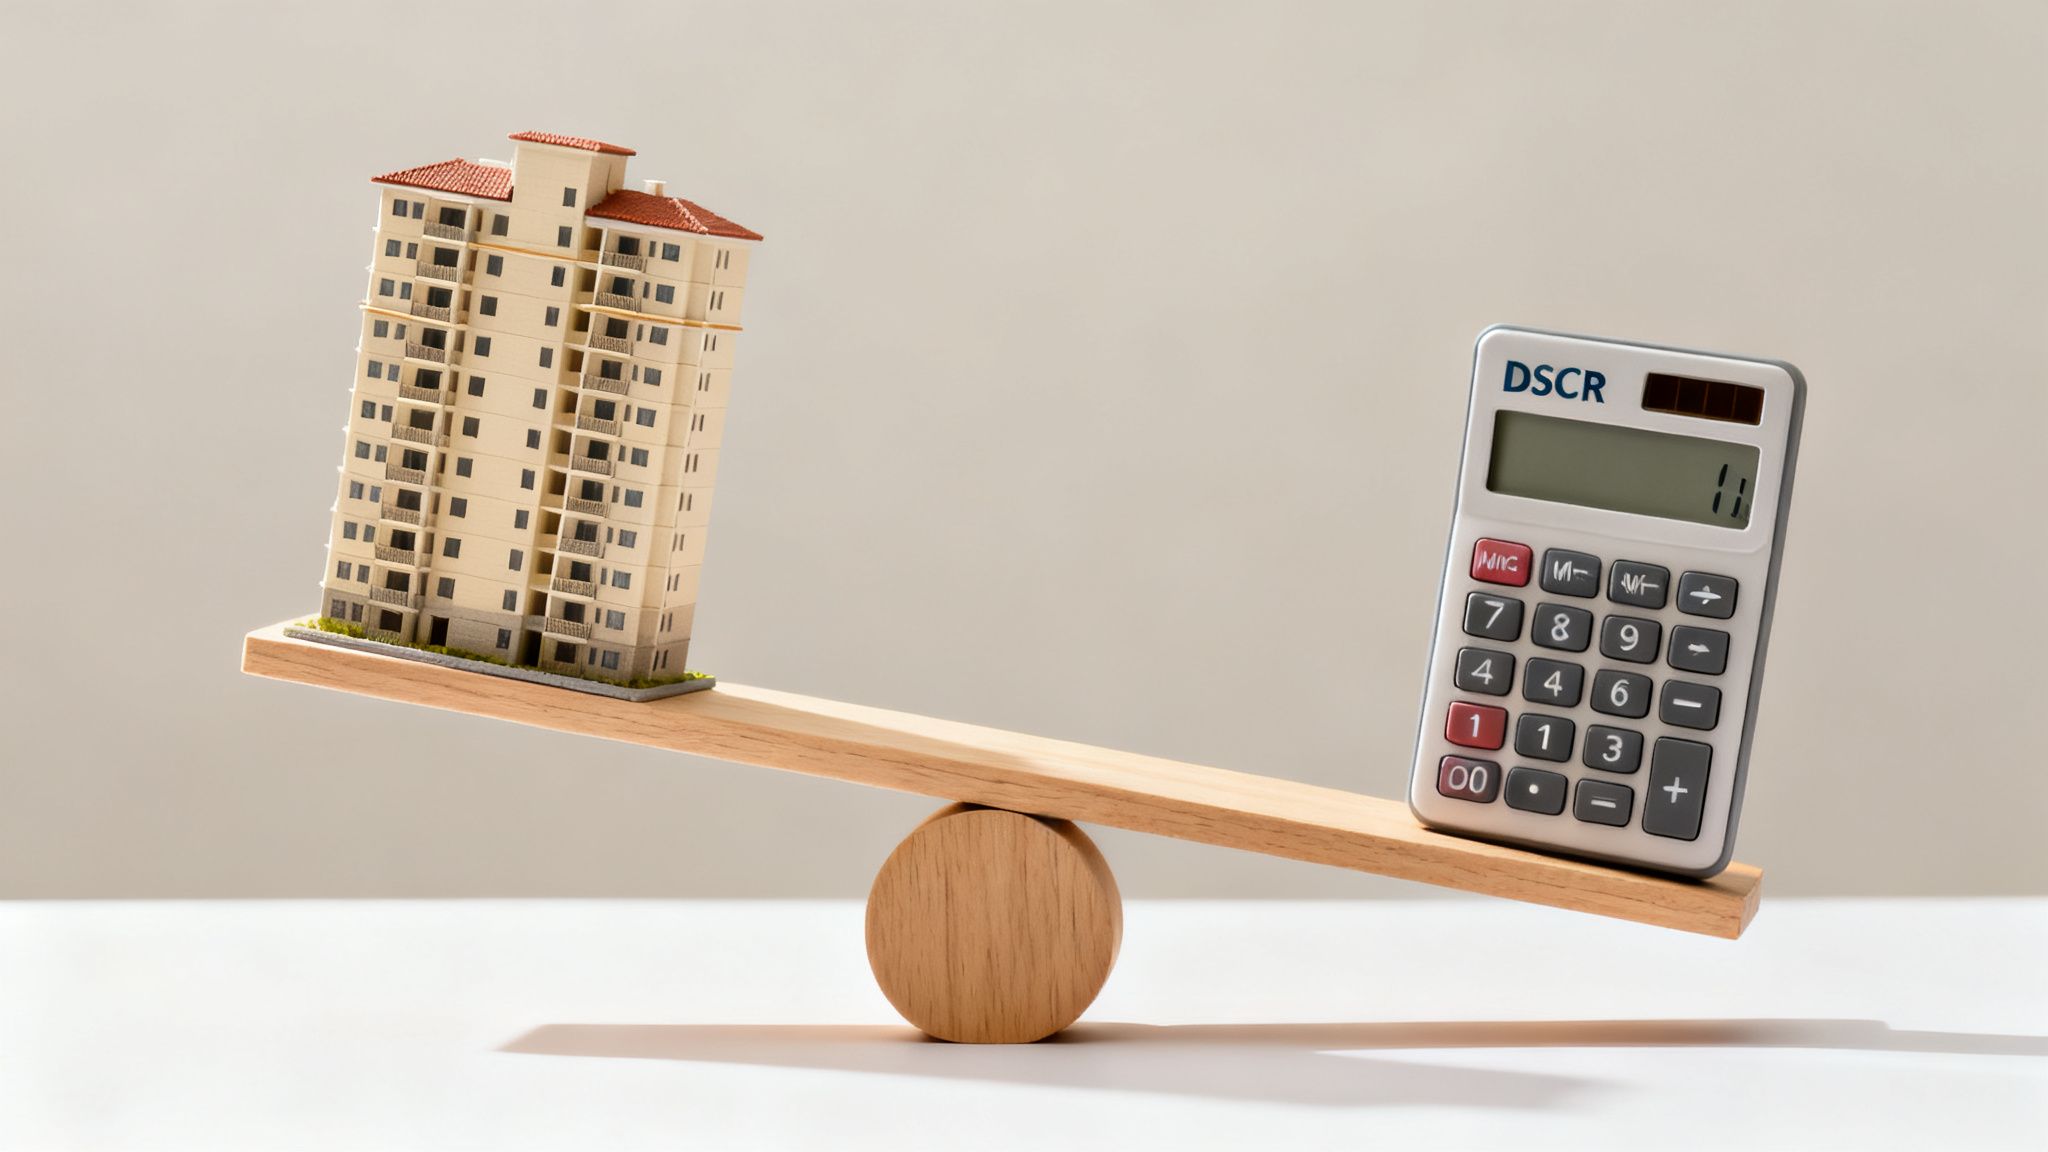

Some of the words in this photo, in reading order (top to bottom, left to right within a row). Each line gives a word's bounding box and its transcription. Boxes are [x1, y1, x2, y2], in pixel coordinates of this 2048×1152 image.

[1503, 360, 1606, 403] DSCR
[1484, 600, 1505, 629] 7
[1551, 613, 1570, 641] 8
[1620, 624, 1639, 651] 9
[1471, 659, 1493, 685] 4
[1543, 670, 1563, 697] 4
[1610, 679, 1630, 707] 6
[1469, 713, 1480, 738] 1
[1537, 724, 1551, 750] 1
[1602, 735, 1623, 762] 3
